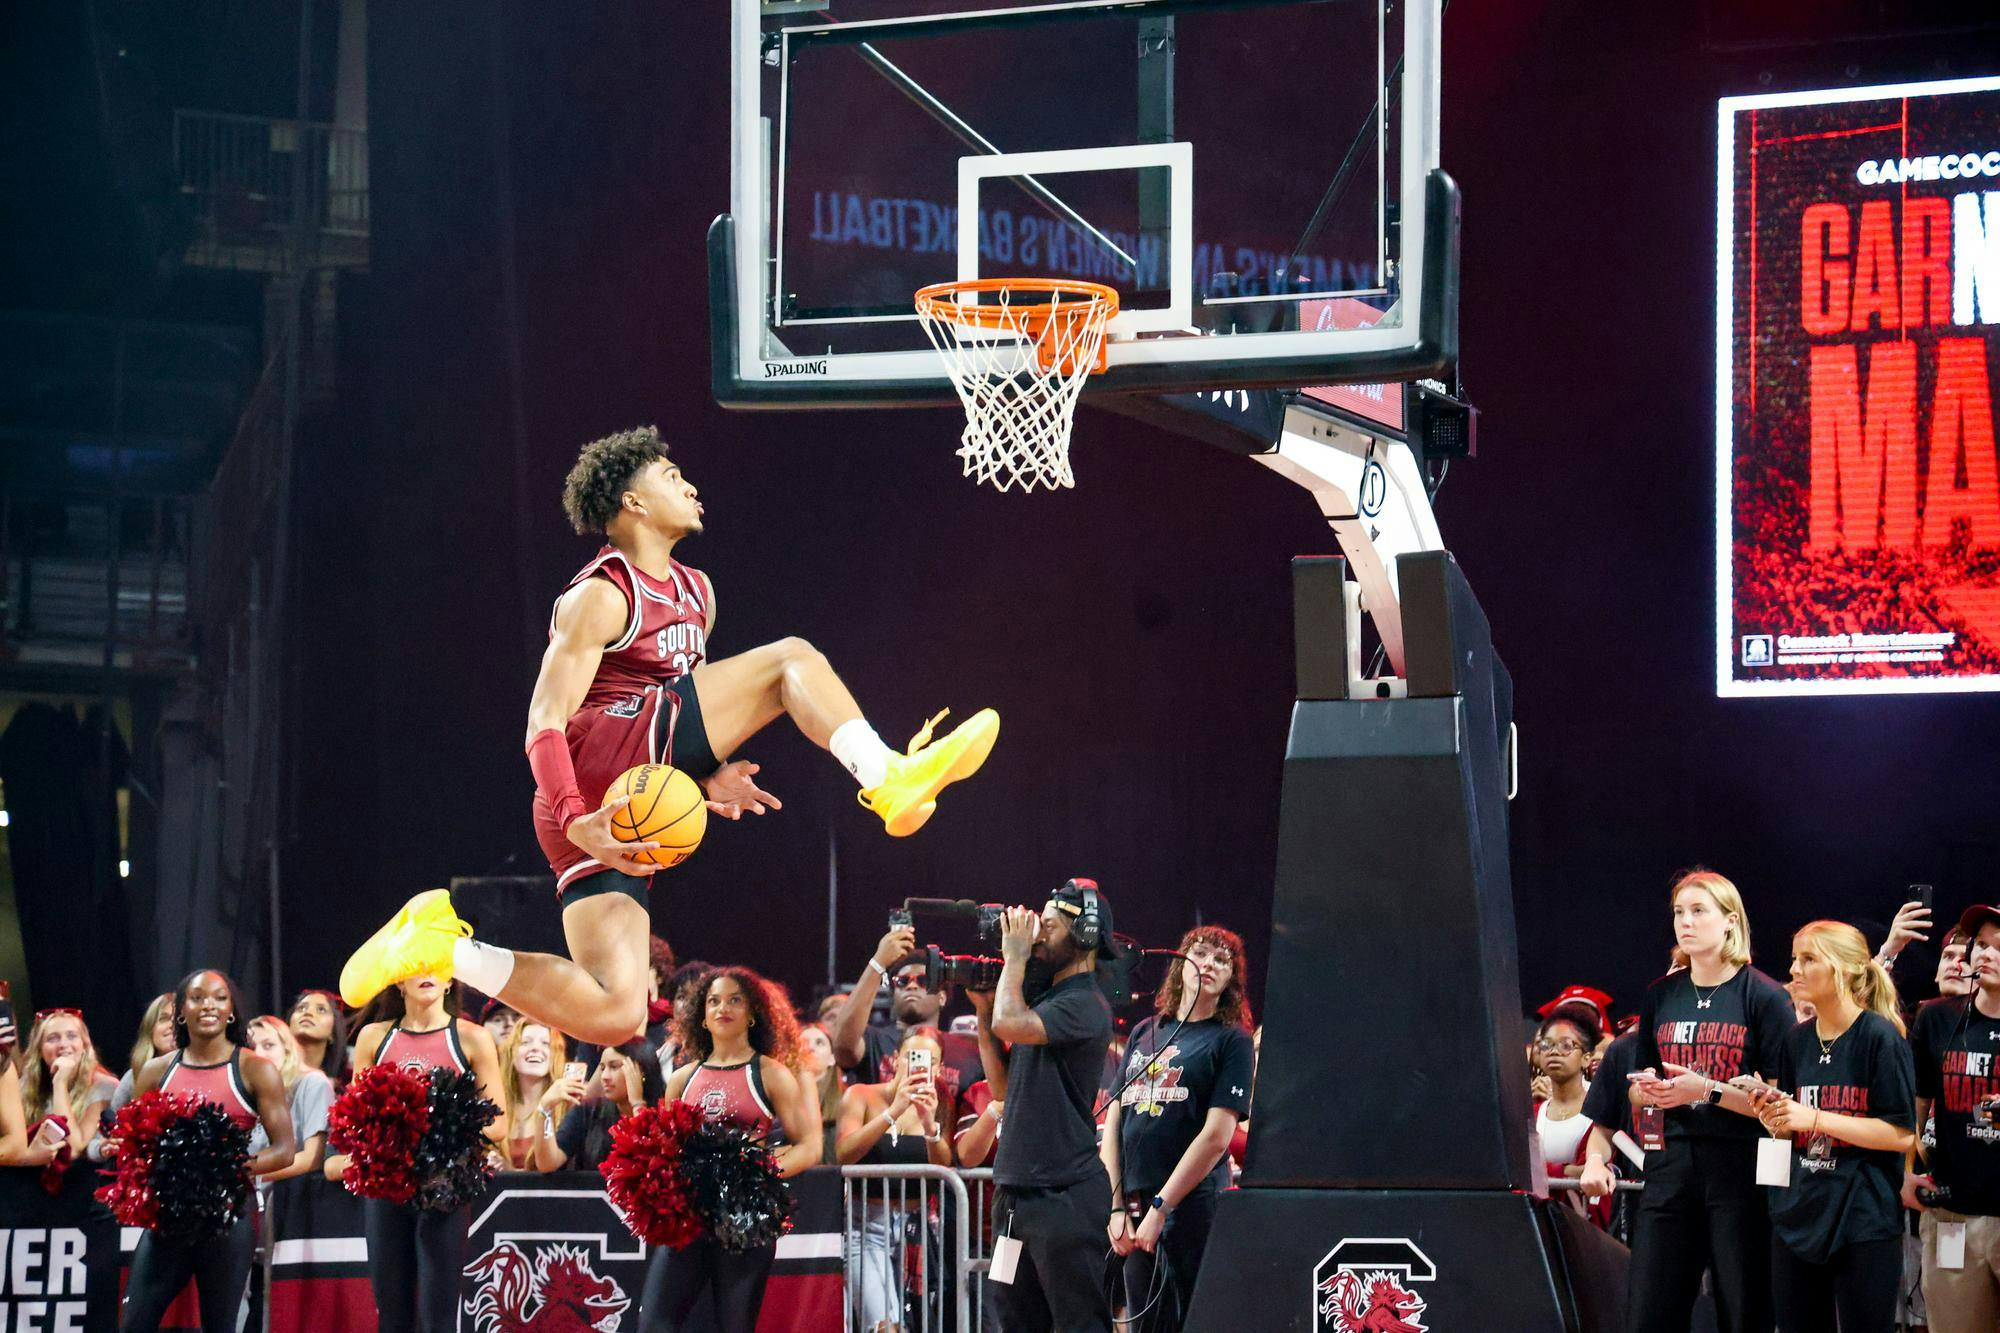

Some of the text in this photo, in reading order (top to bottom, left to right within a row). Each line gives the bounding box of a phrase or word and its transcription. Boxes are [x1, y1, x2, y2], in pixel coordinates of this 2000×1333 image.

[764, 360, 827, 378] SPALDING
[657, 622, 705, 659] SOUTH
[1797, 1085, 1819, 1109] NET
